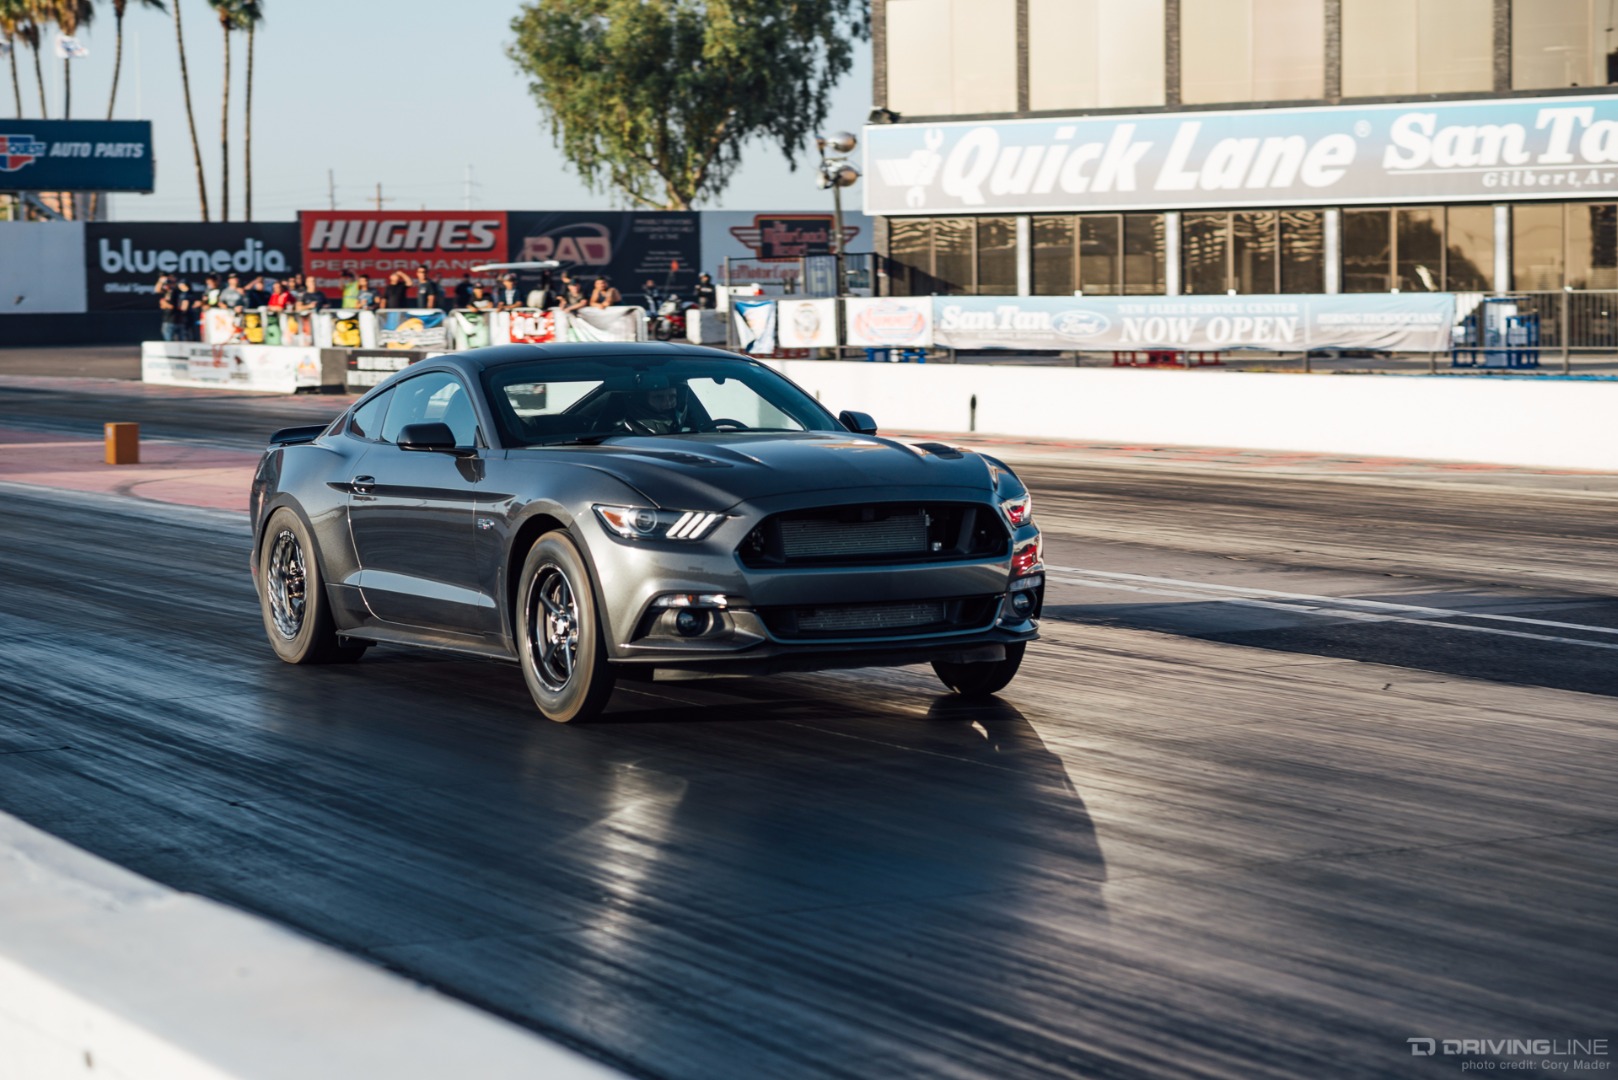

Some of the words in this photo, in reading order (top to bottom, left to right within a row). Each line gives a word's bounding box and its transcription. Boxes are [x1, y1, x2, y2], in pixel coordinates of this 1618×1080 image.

[49, 142, 92, 157] AUTO
[94, 142, 144, 158] PARTS
[942, 121, 1154, 205] Quick
[1153, 121, 1357, 191] Lane
[308, 219, 500, 251] HUGHES
[99, 238, 287, 274] bluemedia
[522, 236, 612, 266] RAD
[1246, 303, 1298, 314] CENTER
[1118, 316, 1200, 344] NOW
[1205, 316, 1300, 345] OPEN
